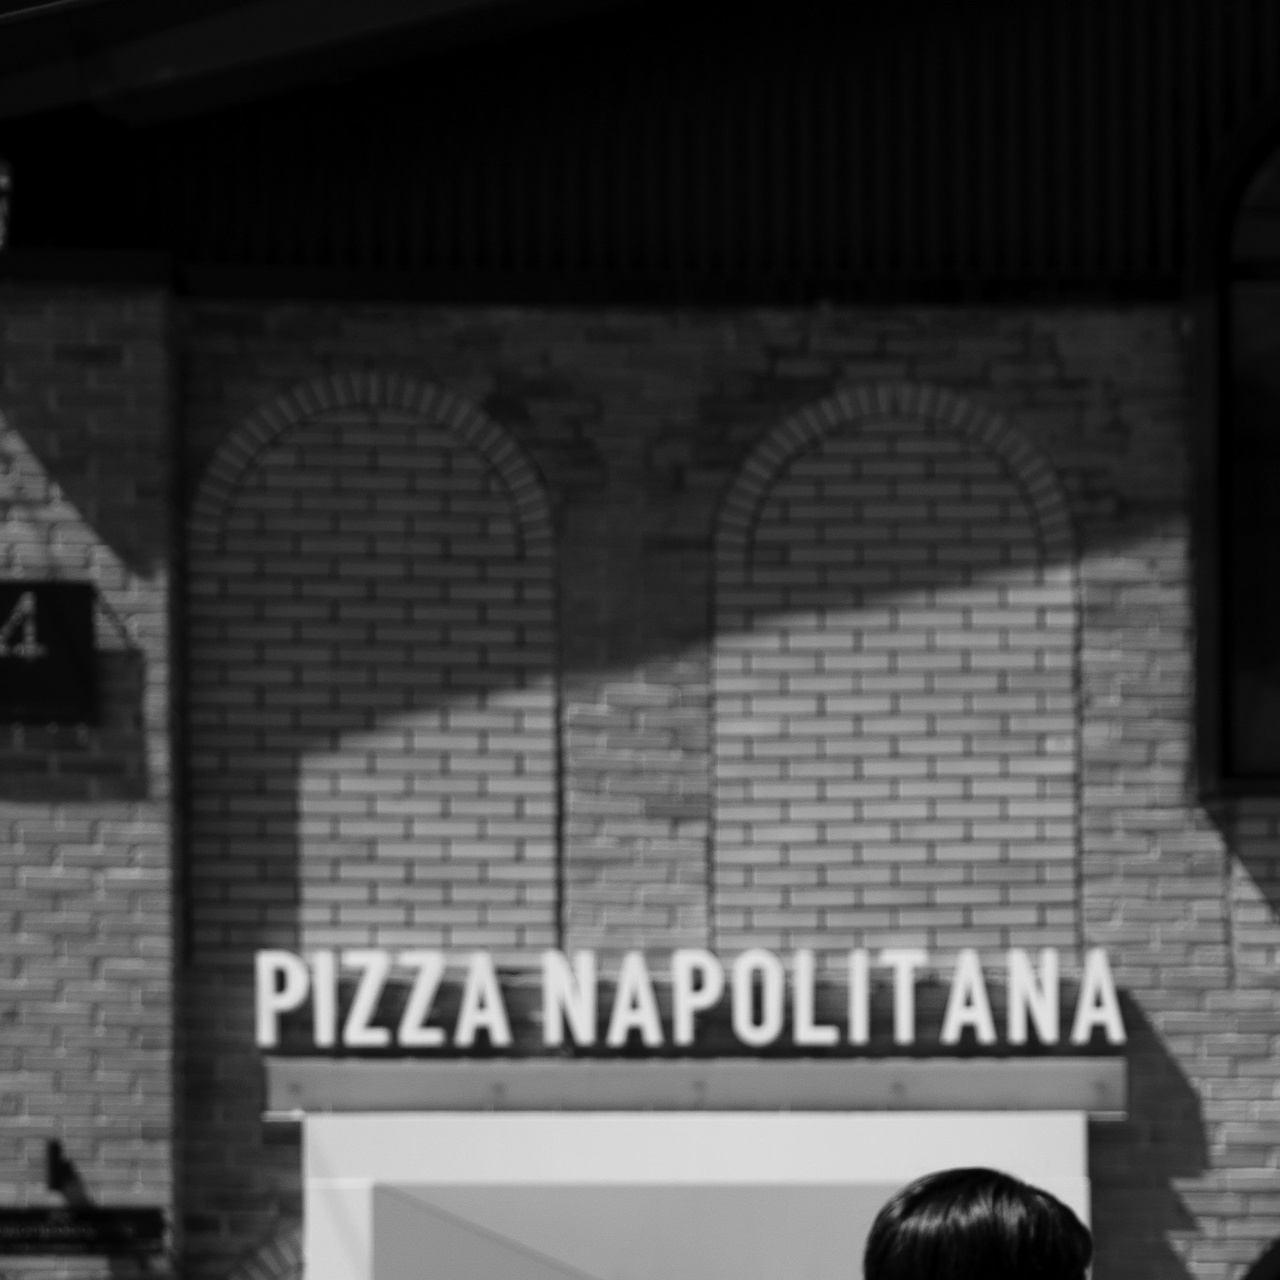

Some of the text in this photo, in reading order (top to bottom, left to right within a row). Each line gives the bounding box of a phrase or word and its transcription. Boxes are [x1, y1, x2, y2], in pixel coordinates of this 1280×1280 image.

[0, 590, 48, 661] 4
[255, 948, 1128, 1048] PIZZA NAPOLITANA
